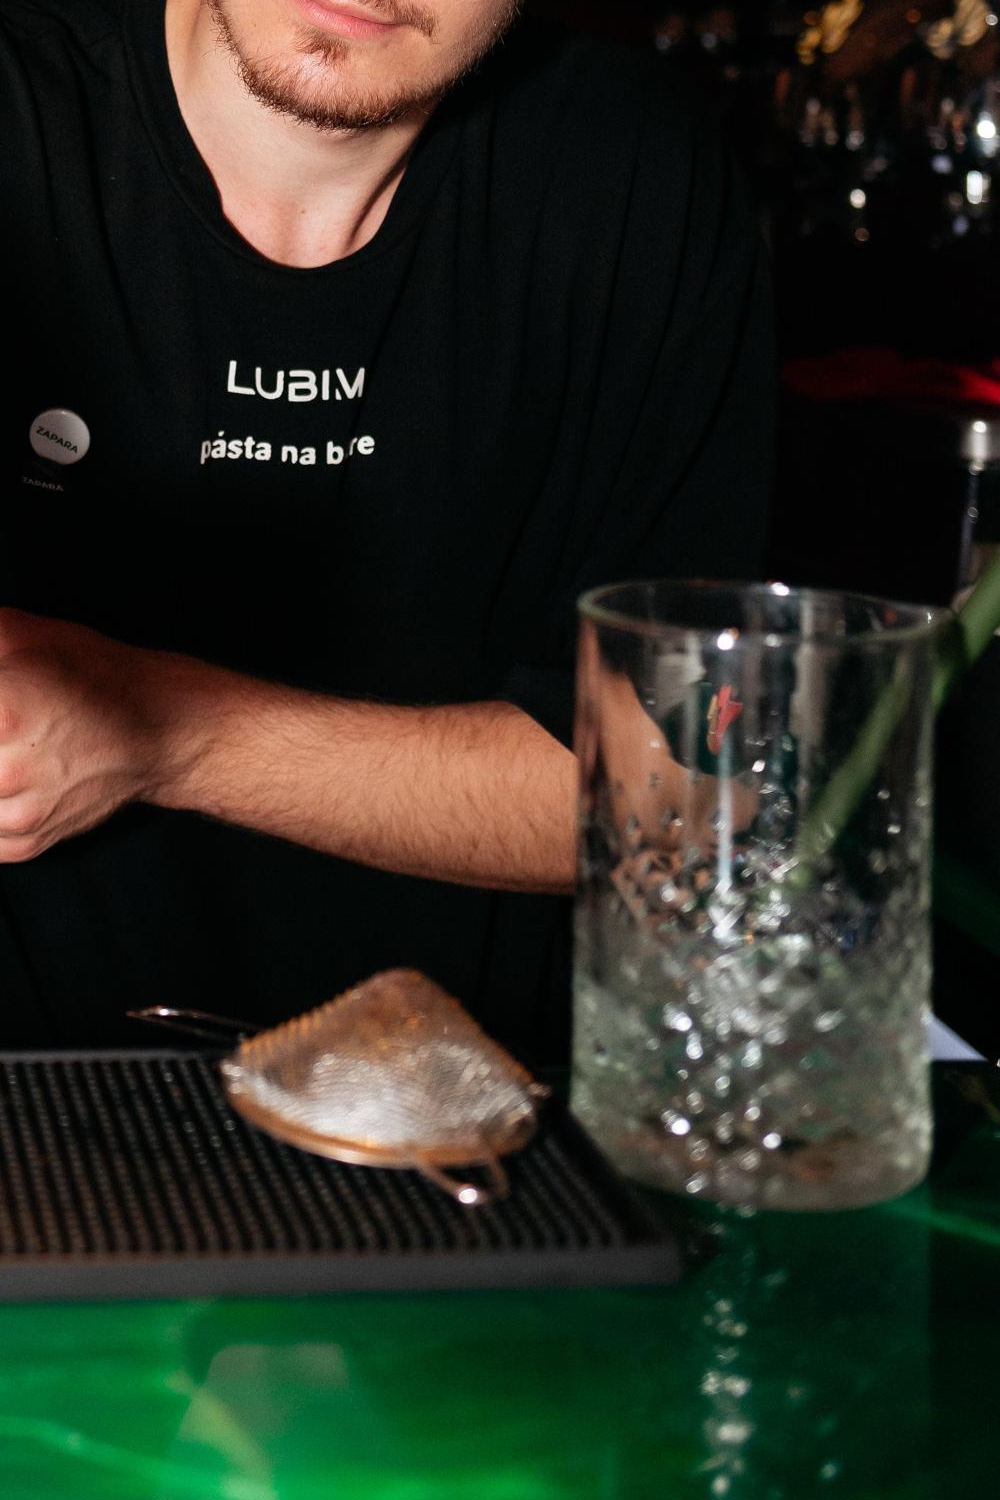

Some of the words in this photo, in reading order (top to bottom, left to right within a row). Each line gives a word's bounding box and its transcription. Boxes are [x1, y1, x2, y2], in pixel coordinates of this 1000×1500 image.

[36, 425, 79, 454] ZAPARA
[200, 430, 272, 465] pásta
[281, 445, 317, 466] na
